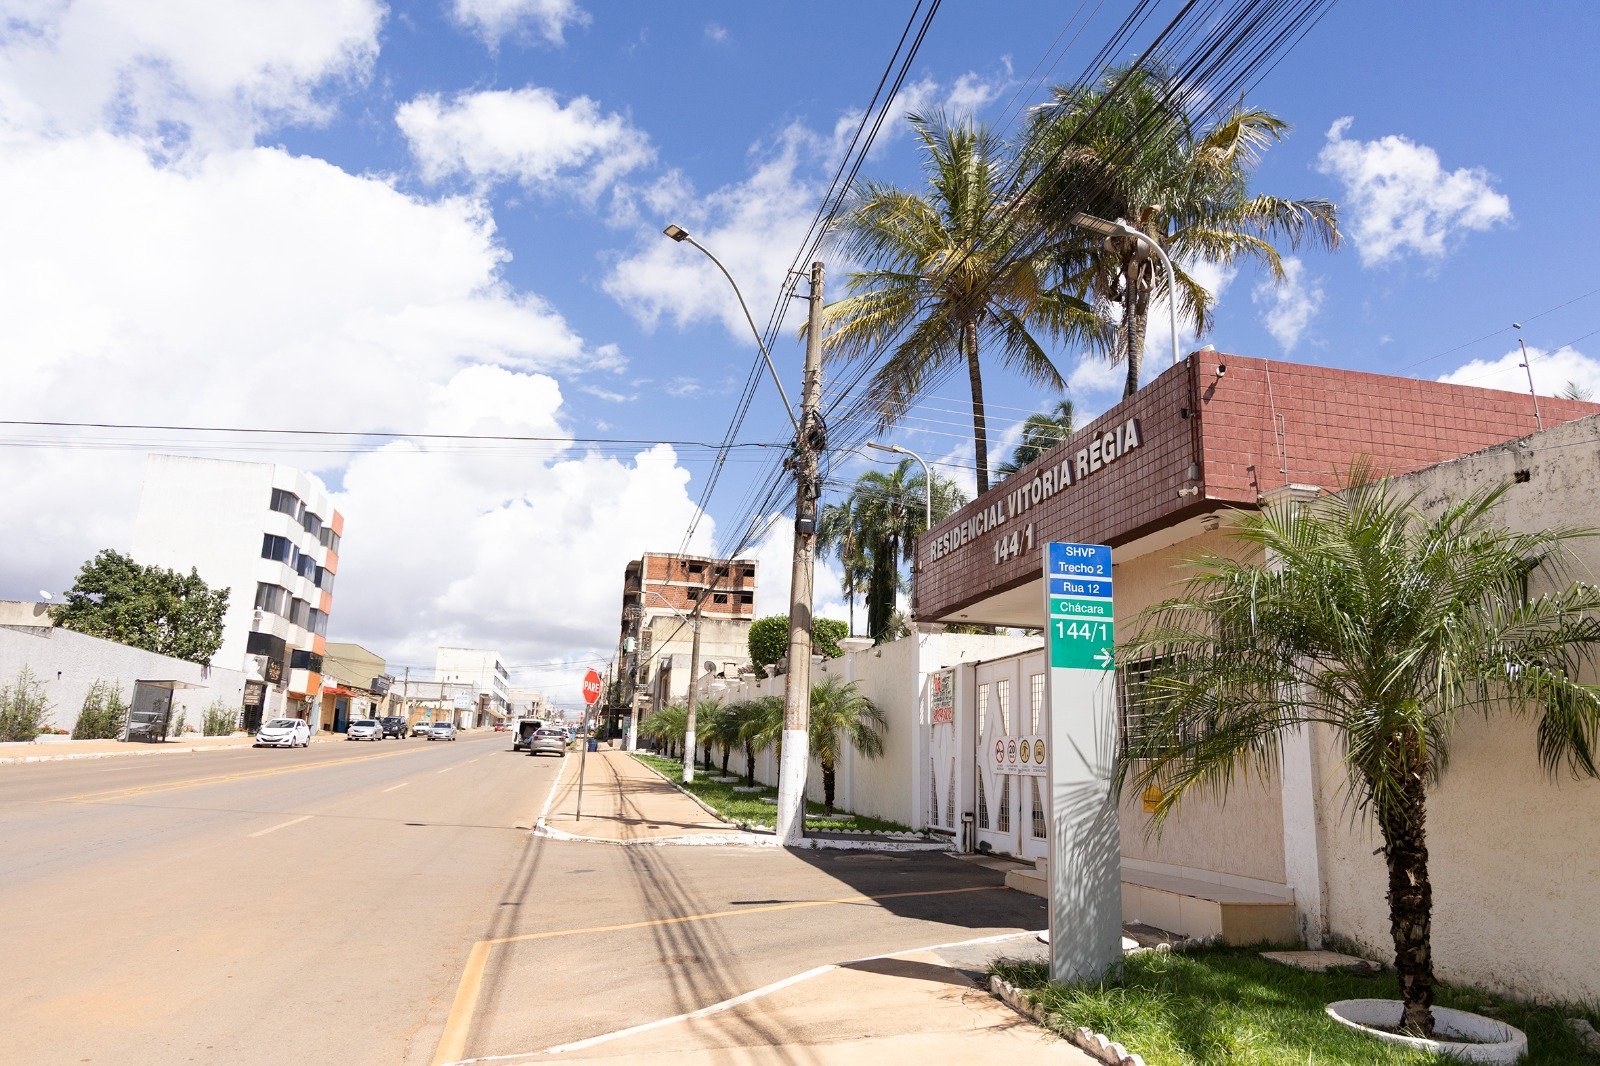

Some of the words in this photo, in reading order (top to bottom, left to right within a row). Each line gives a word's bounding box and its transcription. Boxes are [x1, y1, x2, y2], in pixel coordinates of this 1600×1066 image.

[929, 506, 1004, 562] RESIDENCIAL
[1007, 459, 1074, 517] VITÓRIA
[1076, 417, 1141, 481] RÉGIA
[993, 523, 1035, 565] 144/1
[1065, 546, 1096, 558] SHVP
[1058, 561, 1094, 574] Trecho
[1096, 564, 1104, 574] 2
[1063, 581, 1085, 593] Rua
[1087, 583, 1100, 594] 12
[1059, 601, 1104, 615] Chácara
[1055, 621, 1107, 643] 144/1
[584, 680, 600, 693] PARE
